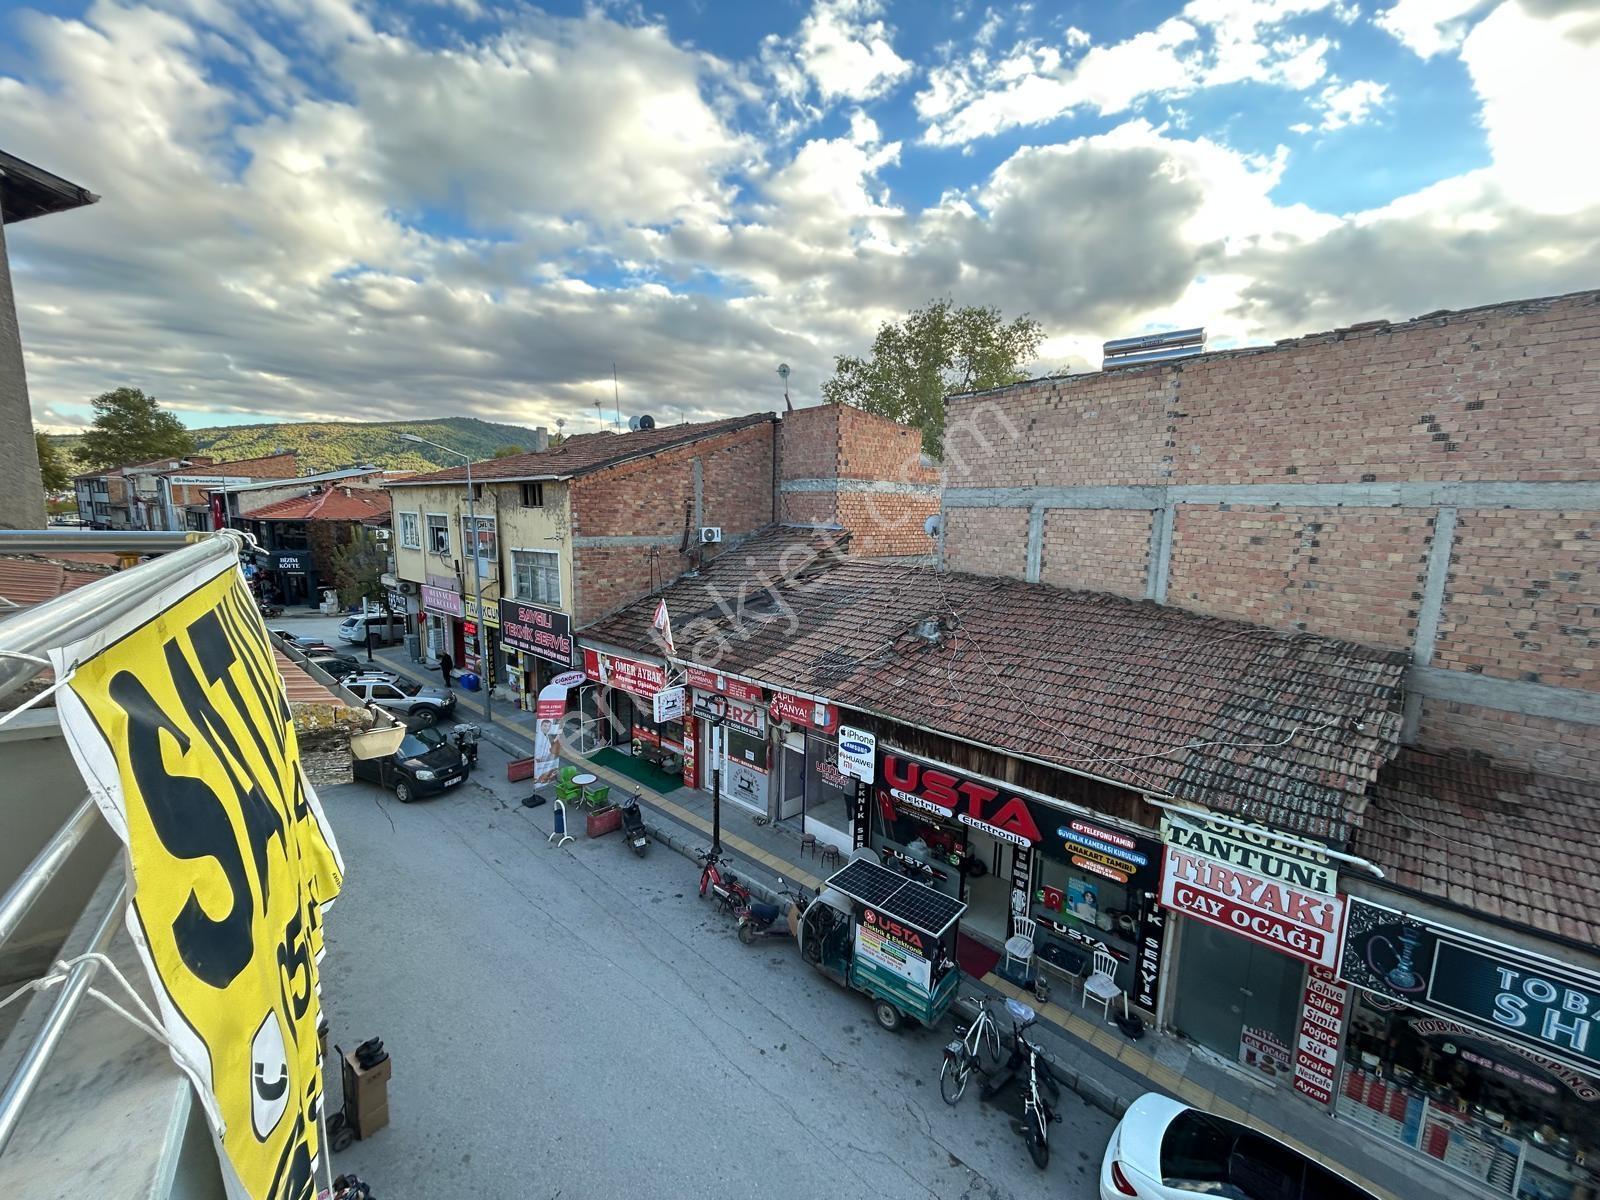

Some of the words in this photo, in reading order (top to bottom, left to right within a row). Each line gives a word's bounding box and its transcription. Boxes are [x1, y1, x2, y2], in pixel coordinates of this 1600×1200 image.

[518, 607, 552, 628] SAYGILI
[504, 621, 533, 642] TEKNİK
[534, 630, 570, 653] SERVİS
[615, 658, 636, 676] ÖMER
[637, 667, 662, 684] AYBAK
[844, 742, 868, 754] SAMSUNG
[847, 729, 874, 745] iPhone
[846, 755, 873, 768] HUAWEI
[884, 755, 1042, 842] USTA
[897, 791, 941, 813] Elektrik
[963, 816, 1025, 846] Elektronik
[1072, 822, 1083, 831] CEP
[1083, 825, 1113, 841] TELEFONU
[894, 850, 934, 874] USTA
[1068, 844, 1104, 861] ANAKART
[1084, 837, 1113, 853] KAMERASI
[1113, 847, 1146, 866] KURULUMU
[878, 916, 924, 948] USTA
[1177, 889, 1224, 917] ÇAY
[1231, 909, 1321, 955] OCAĞI
[863, 921, 885, 936] Elektrik
[892, 936, 923, 956] Elektronik
[1053, 921, 1110, 953] USTA
[1312, 965, 1339, 985] Çay
[1308, 979, 1343, 1001] Kahve
[1308, 993, 1339, 1015] Salep
[1305, 1008, 1338, 1031] Simit
[1492, 993, 1590, 1052] SH
[1302, 1022, 1338, 1047] Poğoça
[1306, 1040, 1328, 1059] Süt
[1299, 1054, 1333, 1076] Oralet
[1298, 1067, 1331, 1089] Nestcafe
[1295, 1080, 1328, 1101] Ayran
